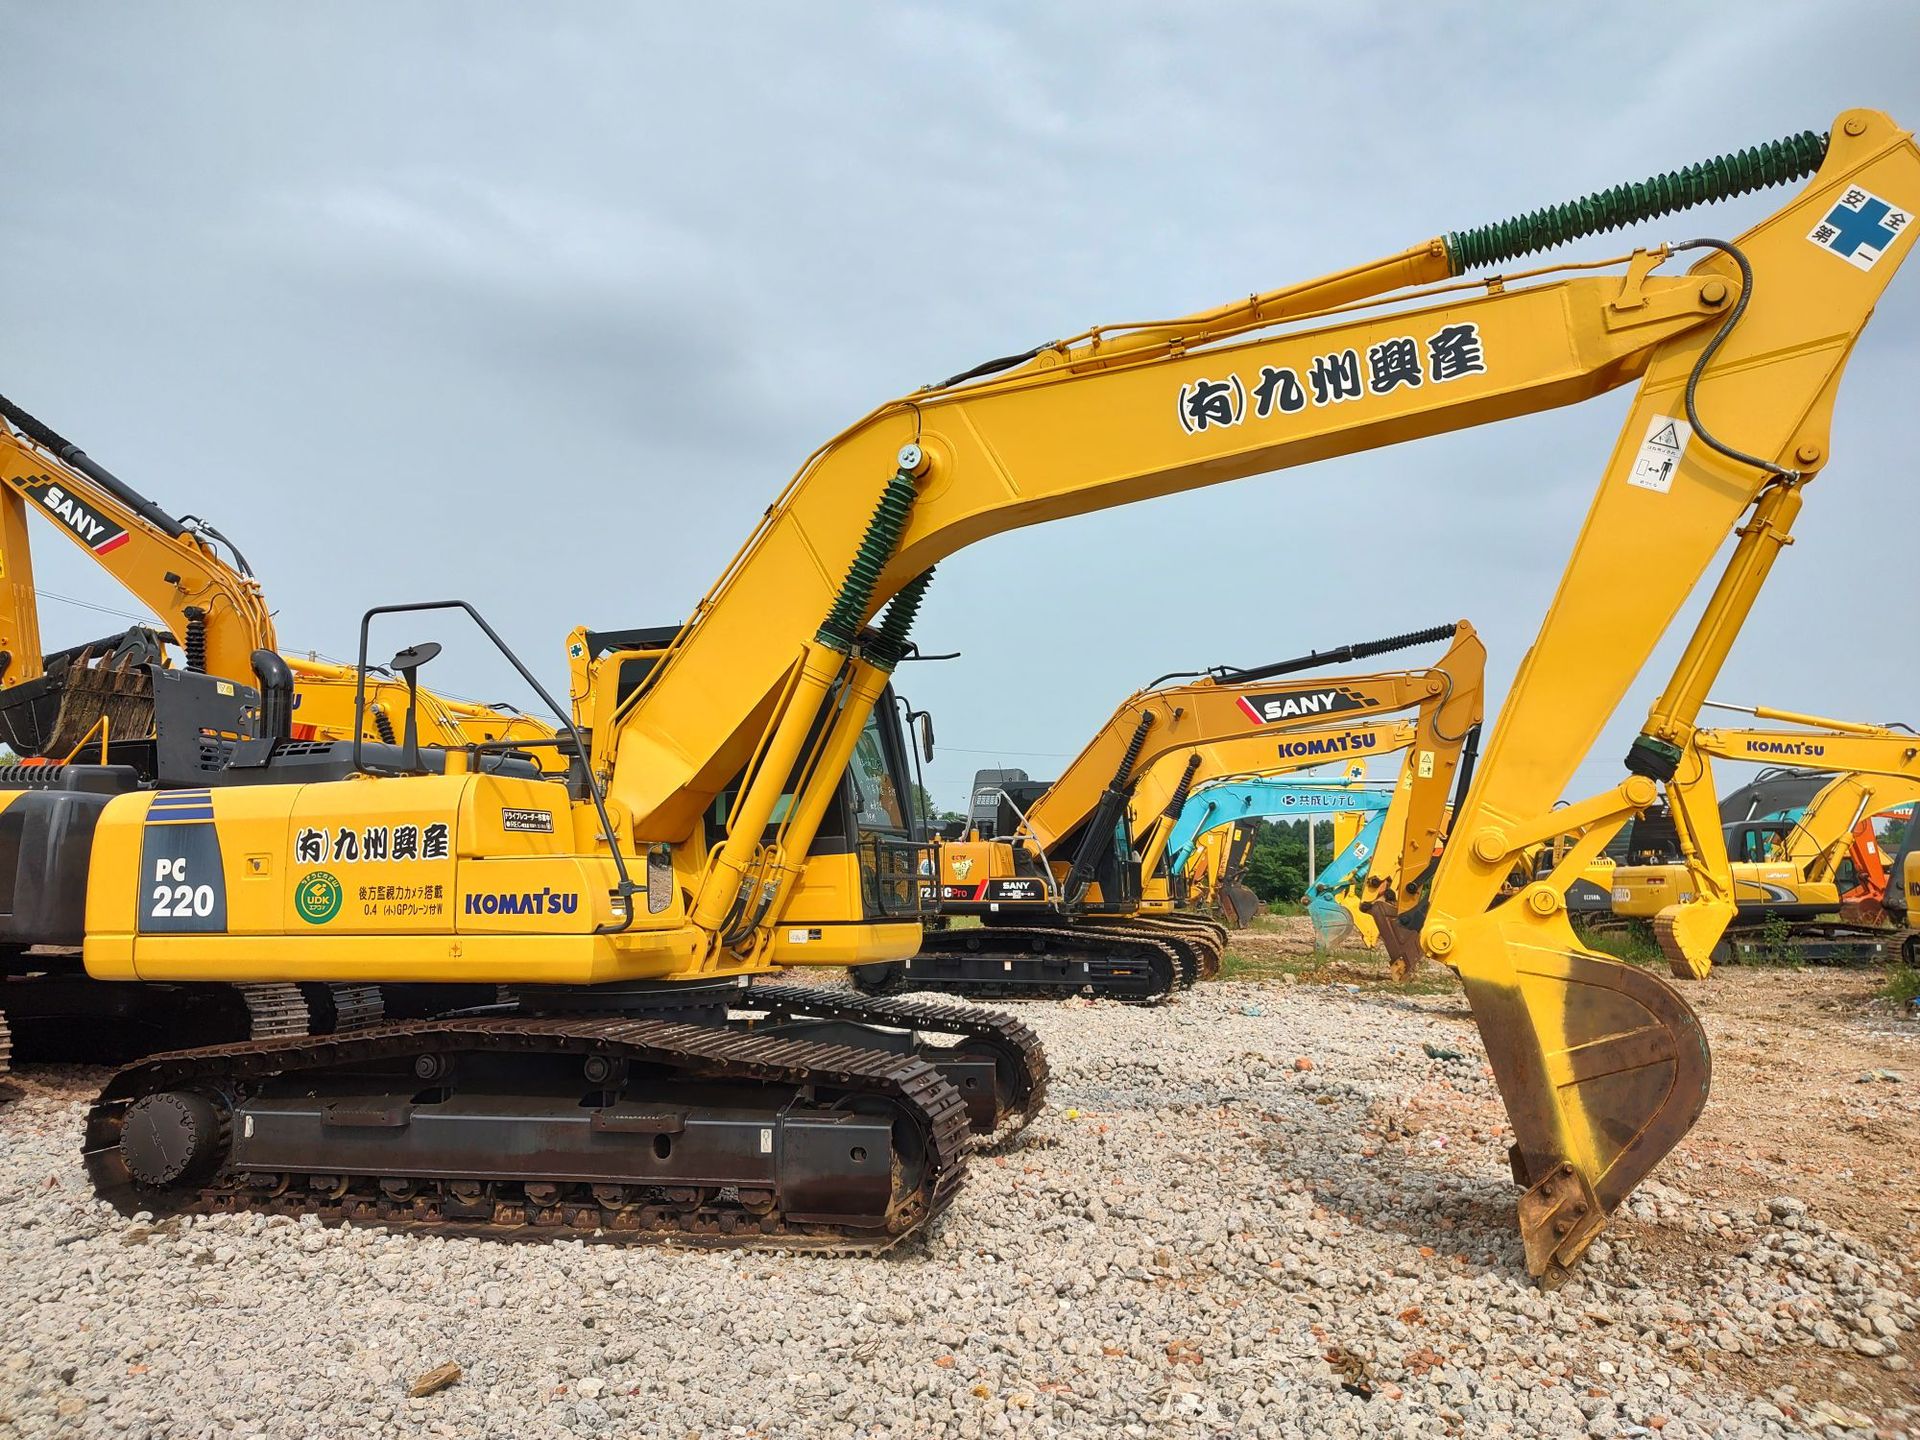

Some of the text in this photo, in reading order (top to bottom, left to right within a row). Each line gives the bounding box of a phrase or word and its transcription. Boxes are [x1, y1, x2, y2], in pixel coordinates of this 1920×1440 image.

[43, 486, 104, 541] SANY
[1264, 692, 1338, 719] SANY
[1278, 733, 1376, 758] KOMATSU
[1746, 740, 1825, 757] KOMATSU
[155, 857, 186, 882] PC
[1002, 882, 1030, 890] SANY
[151, 885, 214, 917] 220
[307, 896, 329, 904] UDK
[364, 904, 377, 915] 0.4
[465, 887, 578, 914] KOMATSU
